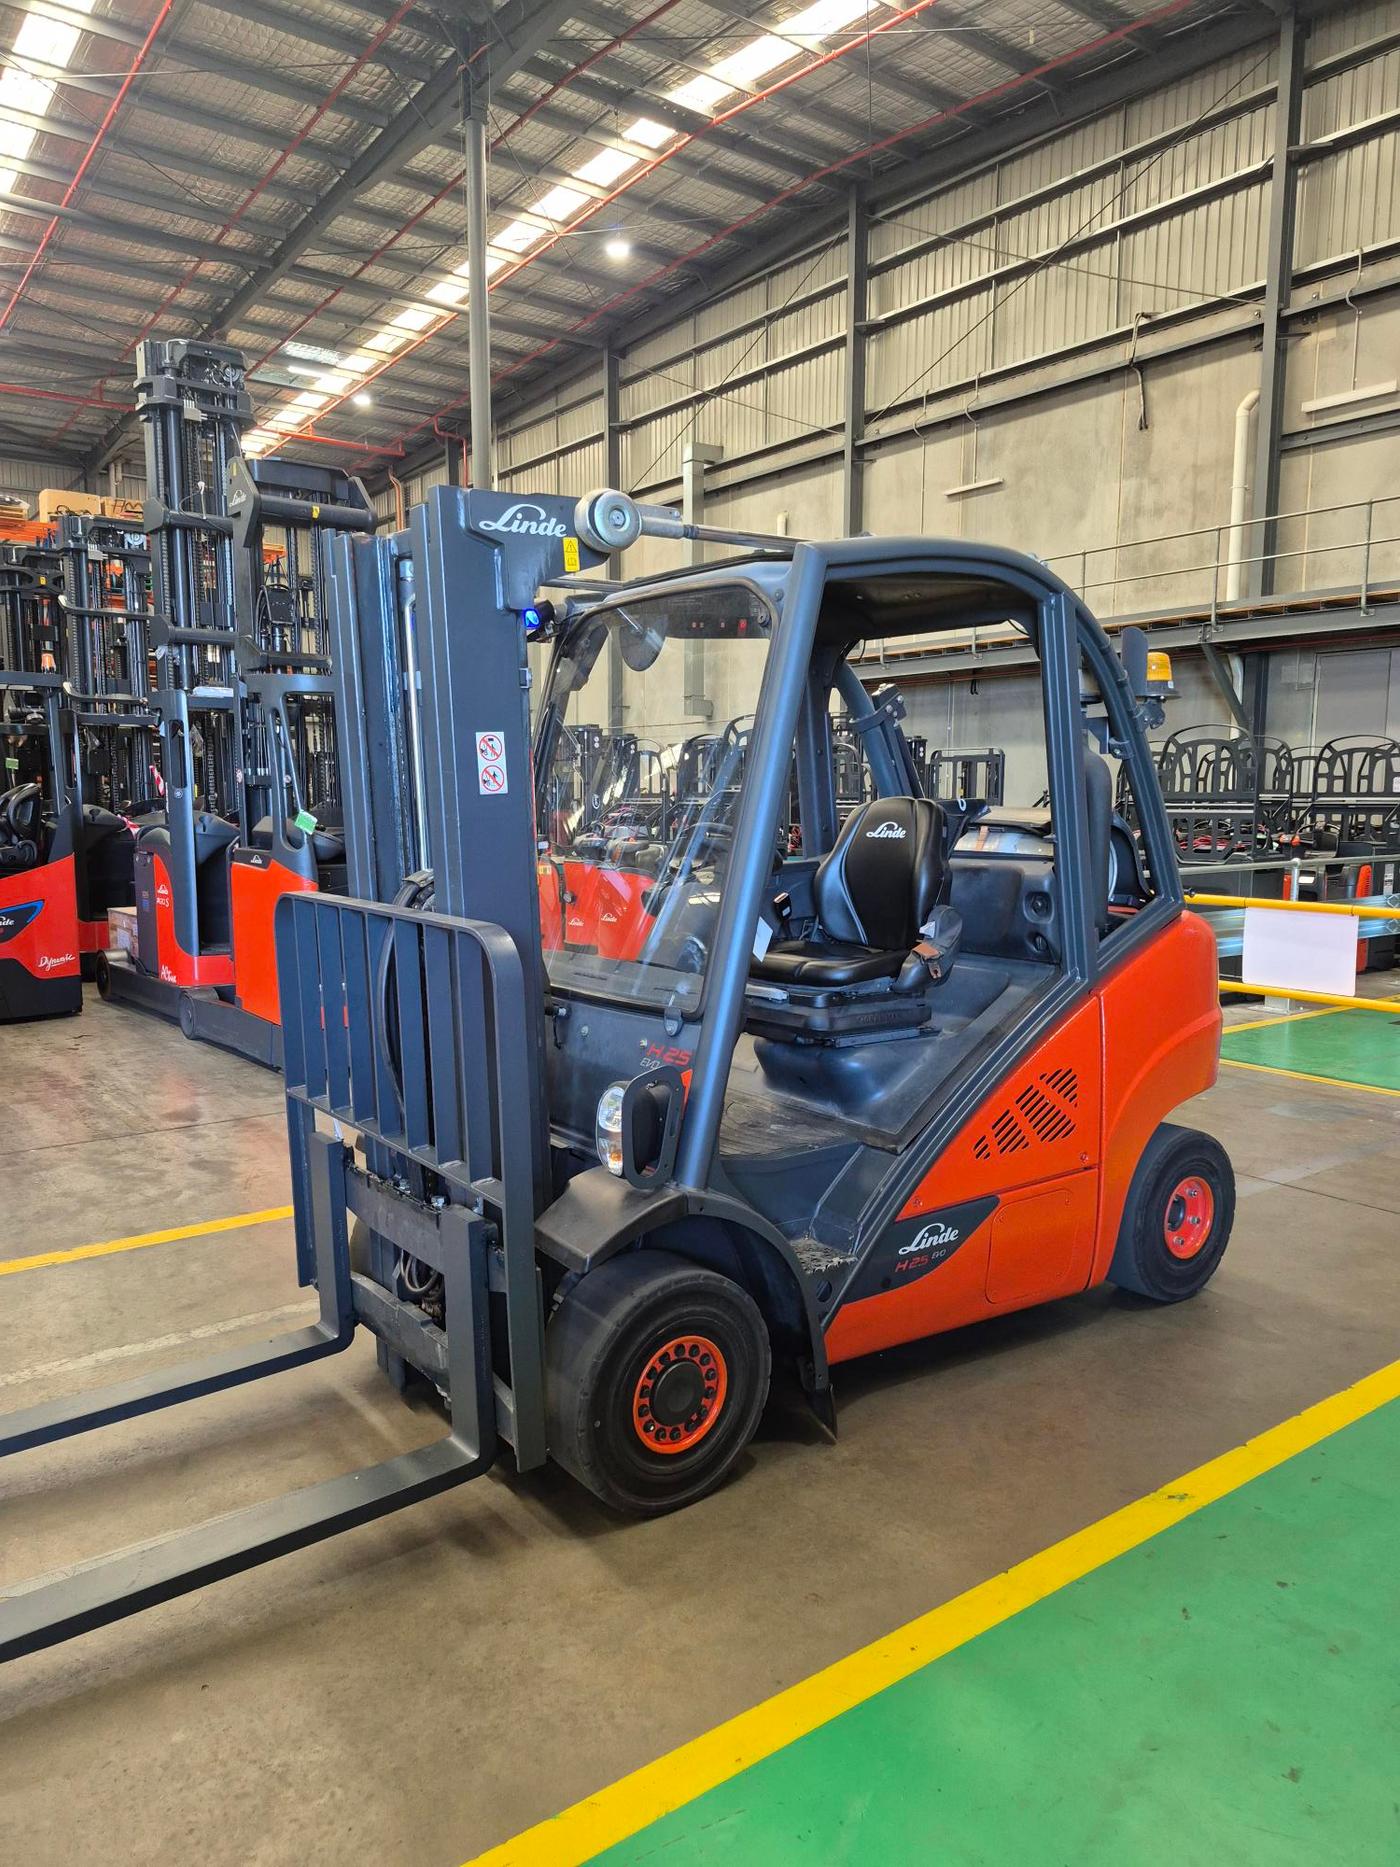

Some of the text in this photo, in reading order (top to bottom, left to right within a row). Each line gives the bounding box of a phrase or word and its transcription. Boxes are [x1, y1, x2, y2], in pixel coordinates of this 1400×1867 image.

[478, 503, 568, 538] Linde
[865, 821, 907, 839] Linde
[898, 1222, 960, 1256] Linde
